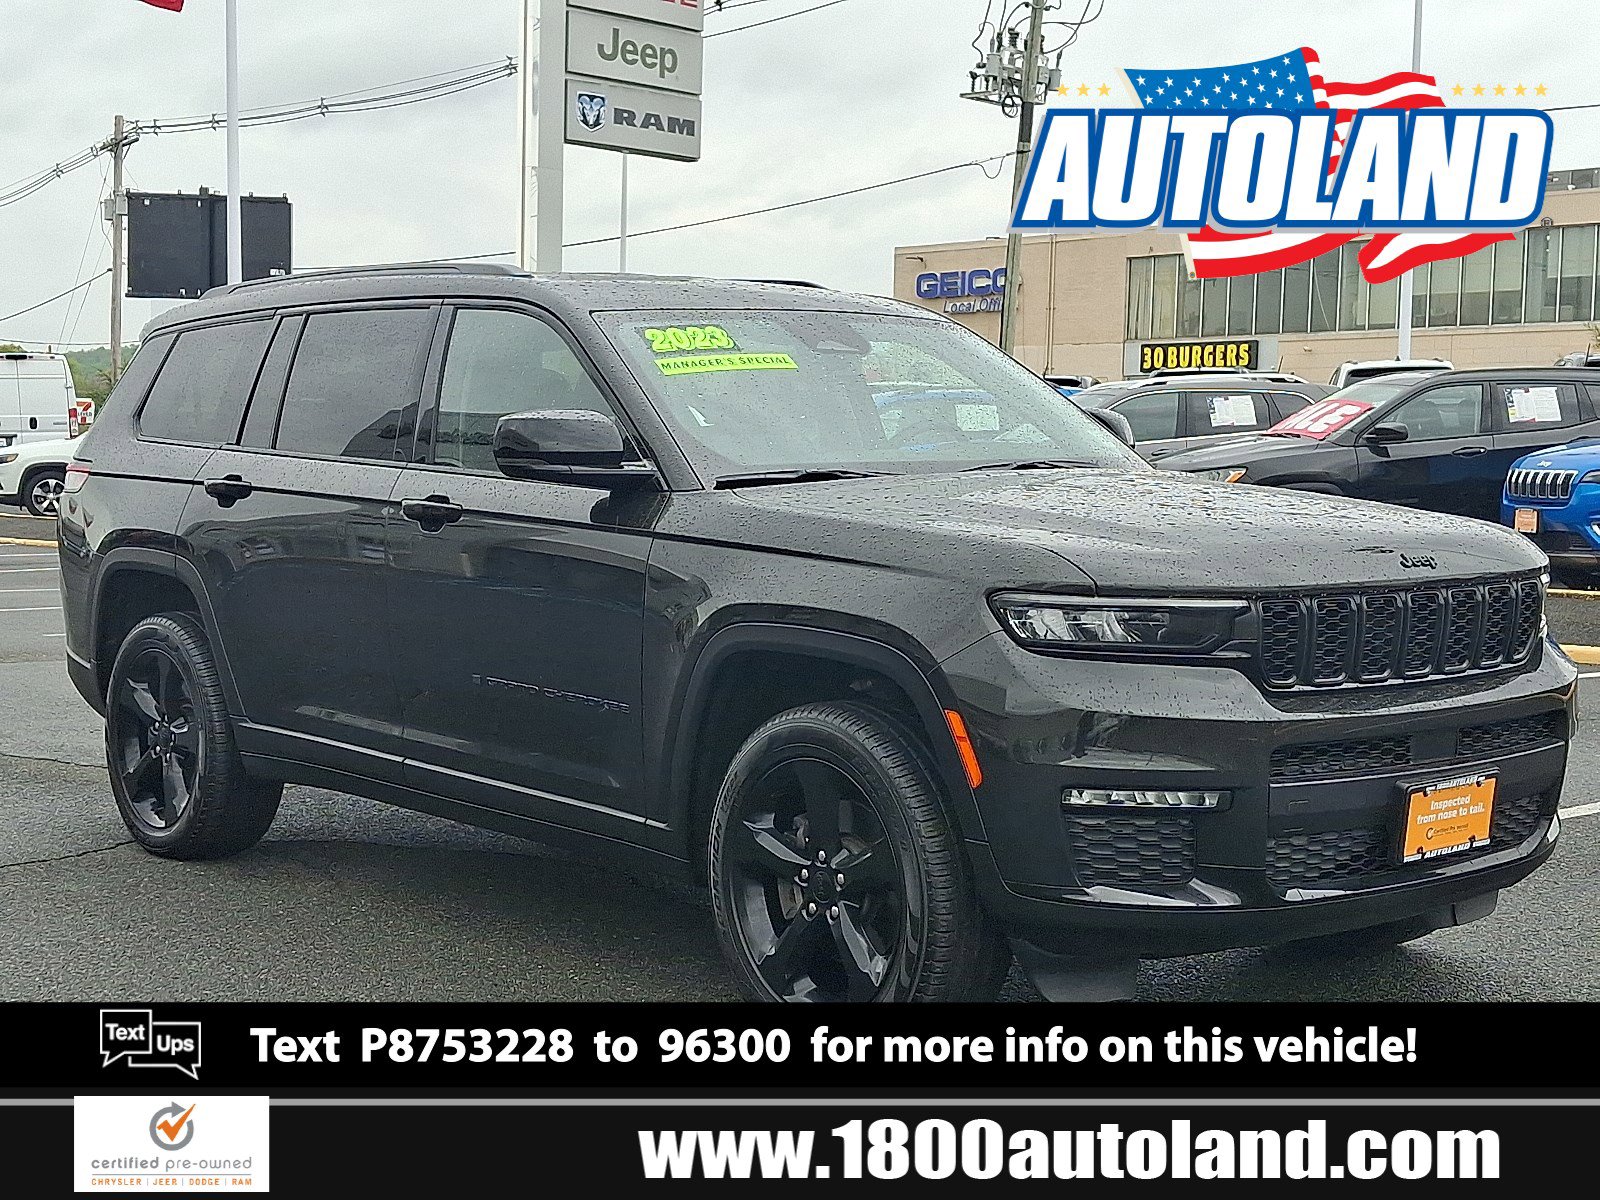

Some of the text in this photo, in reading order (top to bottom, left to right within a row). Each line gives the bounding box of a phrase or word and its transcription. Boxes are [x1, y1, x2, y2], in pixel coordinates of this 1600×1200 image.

[597, 27, 679, 79] Jeep
[613, 107, 696, 137] RAM
[916, 267, 1007, 299] GEICO
[944, 297, 1003, 314] Local Offi
[645, 326, 736, 353] 2023
[661, 356, 790, 371] MANAGER'S SPECIAL
[1143, 343, 1251, 369] 30 BURGERS
[1399, 553, 1438, 570] Jeep
[1430, 794, 1471, 811] Inspected
[1416, 813, 1437, 825] from
[1437, 810, 1457, 820] nose
[1459, 807, 1468, 816] to
[1424, 842, 1471, 859] AUTOLAND
